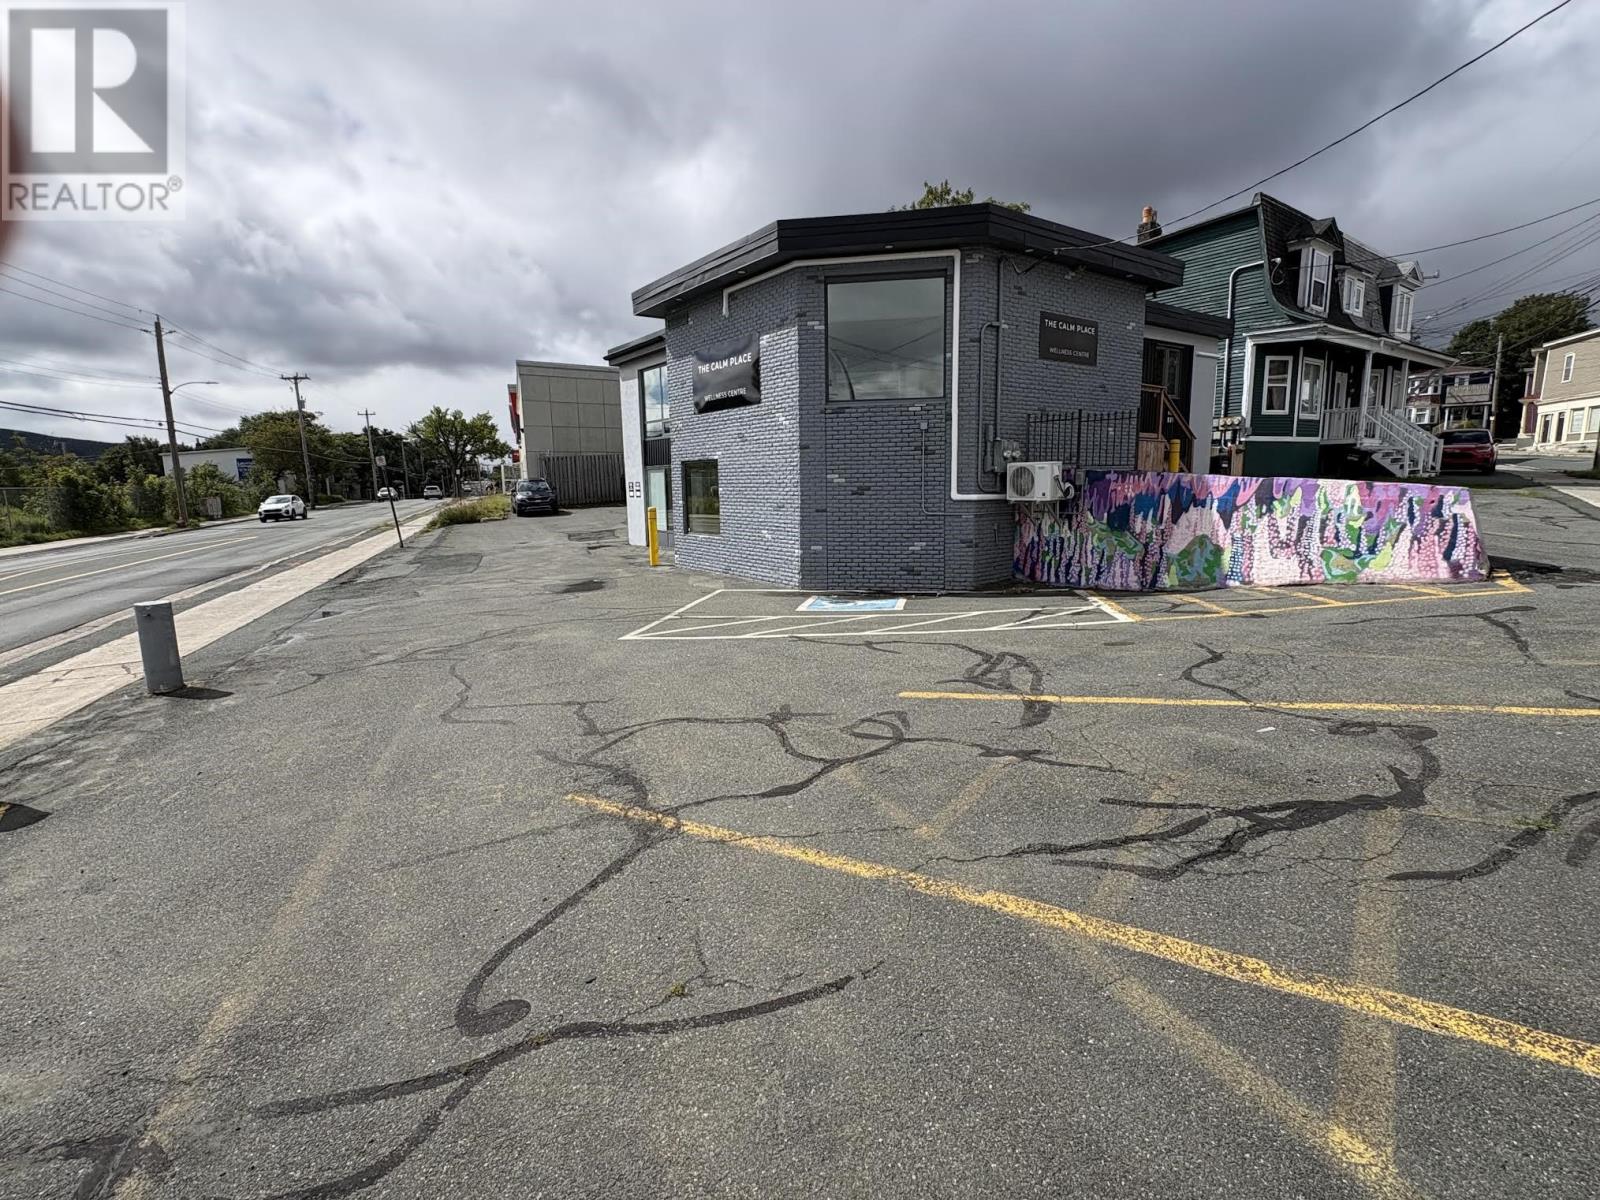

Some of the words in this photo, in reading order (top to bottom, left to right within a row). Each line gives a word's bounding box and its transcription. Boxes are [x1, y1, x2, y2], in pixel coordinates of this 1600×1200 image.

[1044, 319, 1058, 329] THE
[1058, 321, 1076, 332] CALM
[1076, 325, 1096, 336] PLACE
[698, 363, 710, 375] THE
[710, 358, 729, 371] CALM
[729, 352, 752, 367] PLACE
[703, 391, 728, 402] WELLNESS
[727, 387, 747, 398] CENTRE
